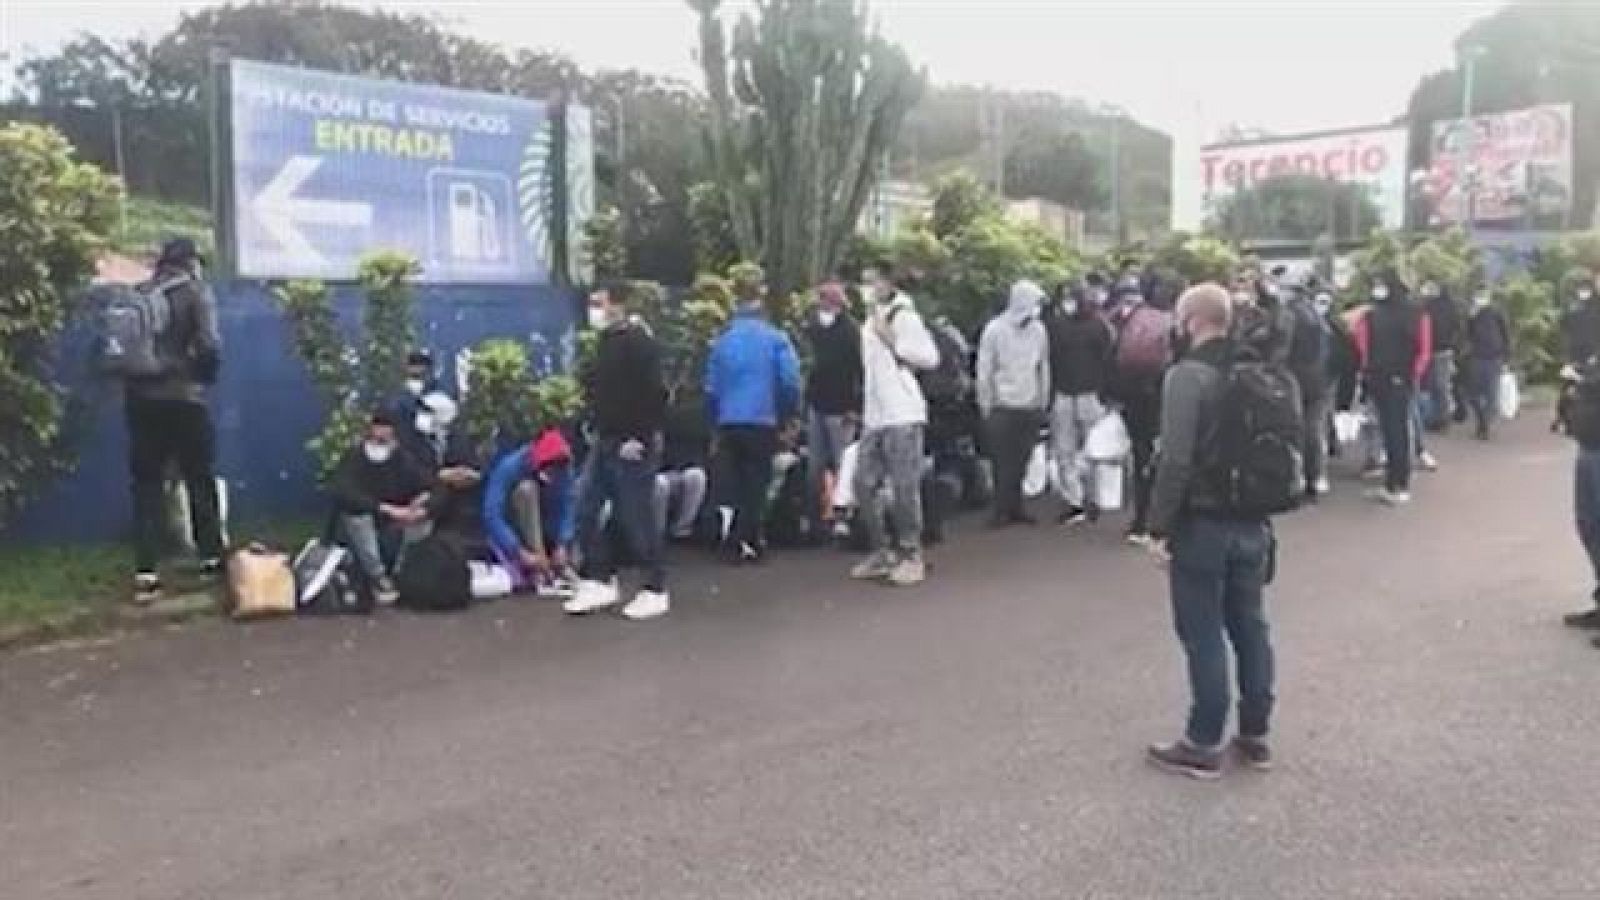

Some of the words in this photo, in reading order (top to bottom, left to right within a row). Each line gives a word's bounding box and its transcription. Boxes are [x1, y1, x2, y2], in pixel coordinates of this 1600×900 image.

[367, 99, 397, 121] DE
[315, 119, 454, 161] ENTRADA
[1200, 140, 1388, 194] Terencio
